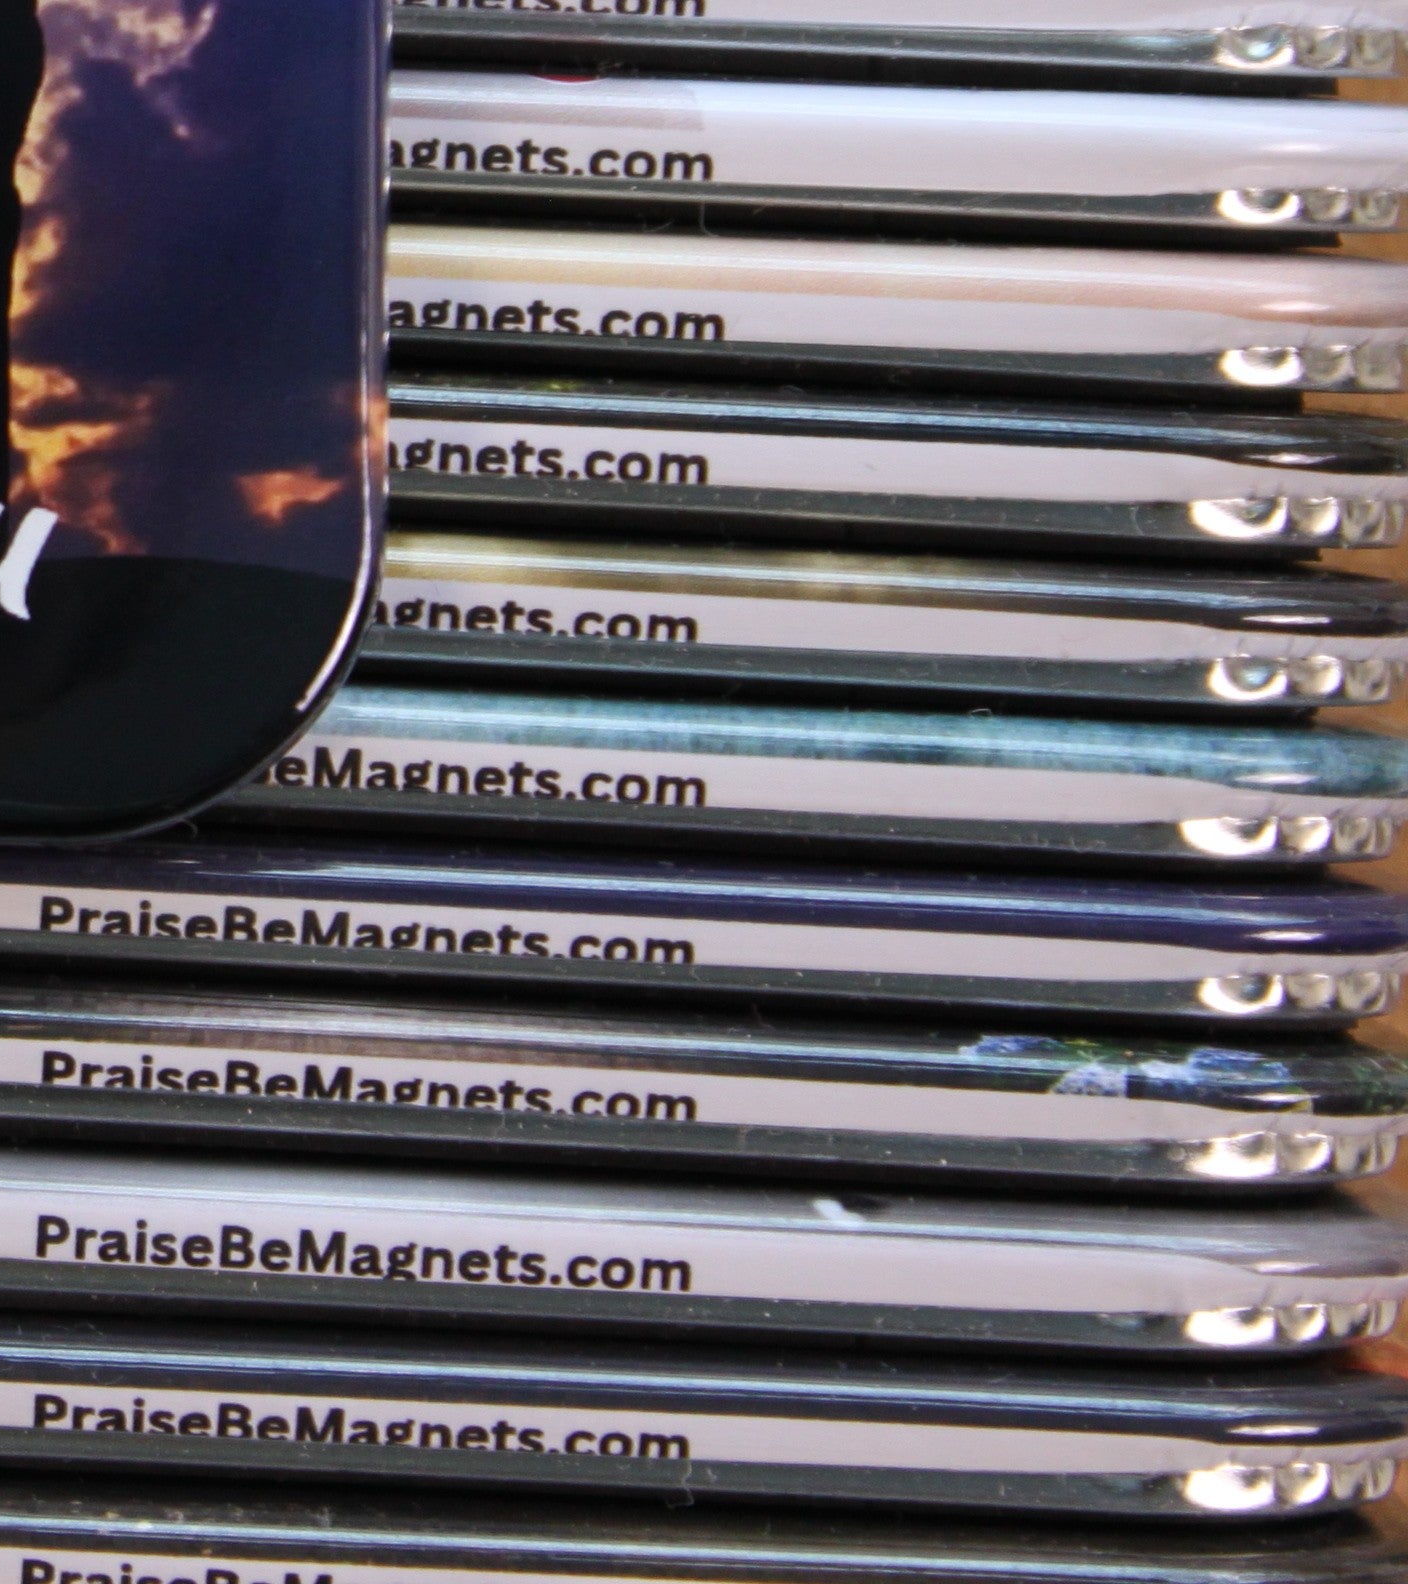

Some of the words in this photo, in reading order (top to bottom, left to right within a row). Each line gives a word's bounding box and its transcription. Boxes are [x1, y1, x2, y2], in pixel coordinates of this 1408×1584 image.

[388, 296, 726, 342] agnets.com
[261, 747, 706, 807] eMagnets.com
[38, 895, 695, 964] PraiseBeMagnets.com
[41, 1050, 697, 1122] PraiseBeMagnets.com
[36, 1215, 692, 1292] PraiseBeMagnets.com
[32, 1394, 690, 1461] PraiseBeMagnets.com
